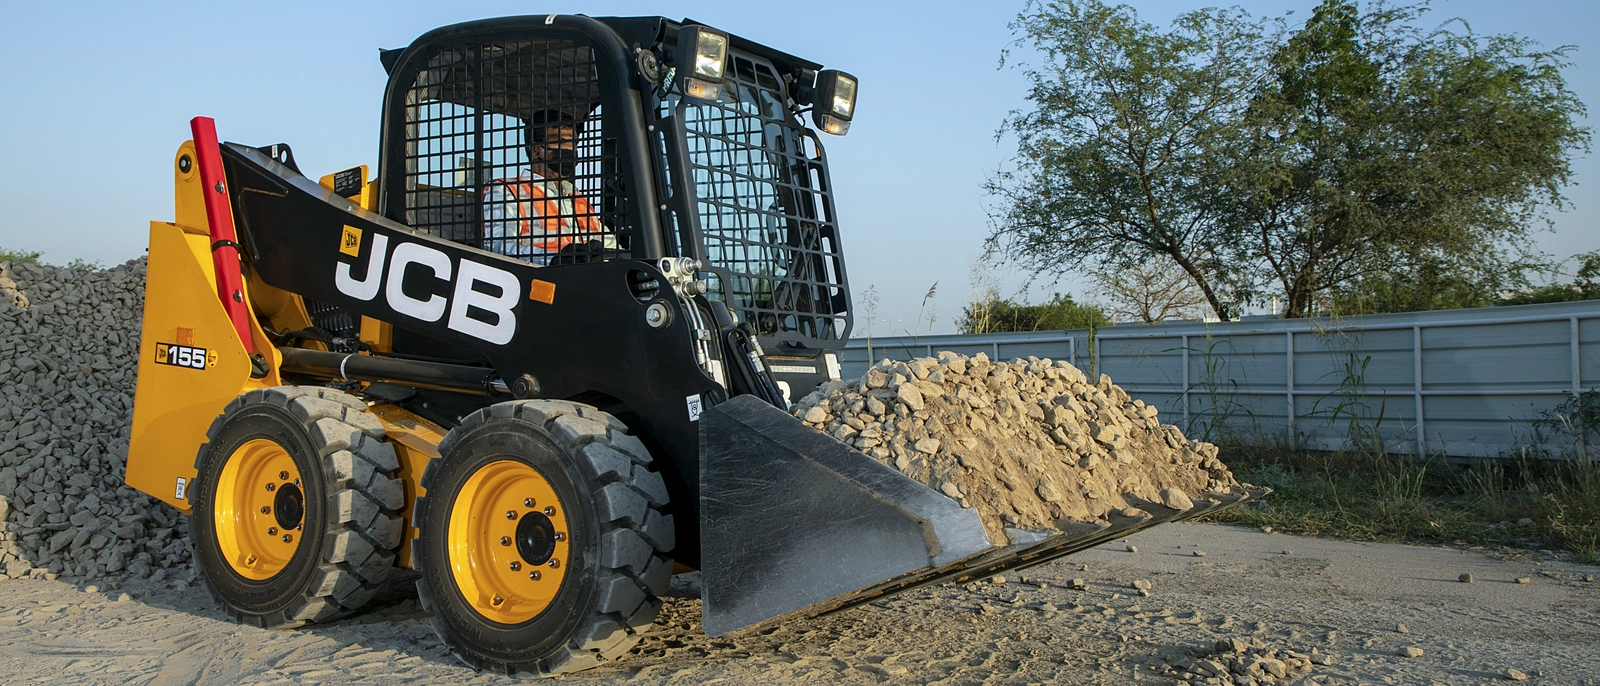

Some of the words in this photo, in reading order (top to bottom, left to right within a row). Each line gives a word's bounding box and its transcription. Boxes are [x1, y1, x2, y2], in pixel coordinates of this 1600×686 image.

[346, 231, 358, 247] JCB
[335, 232, 521, 345] JCB
[168, 345, 206, 369] 155
